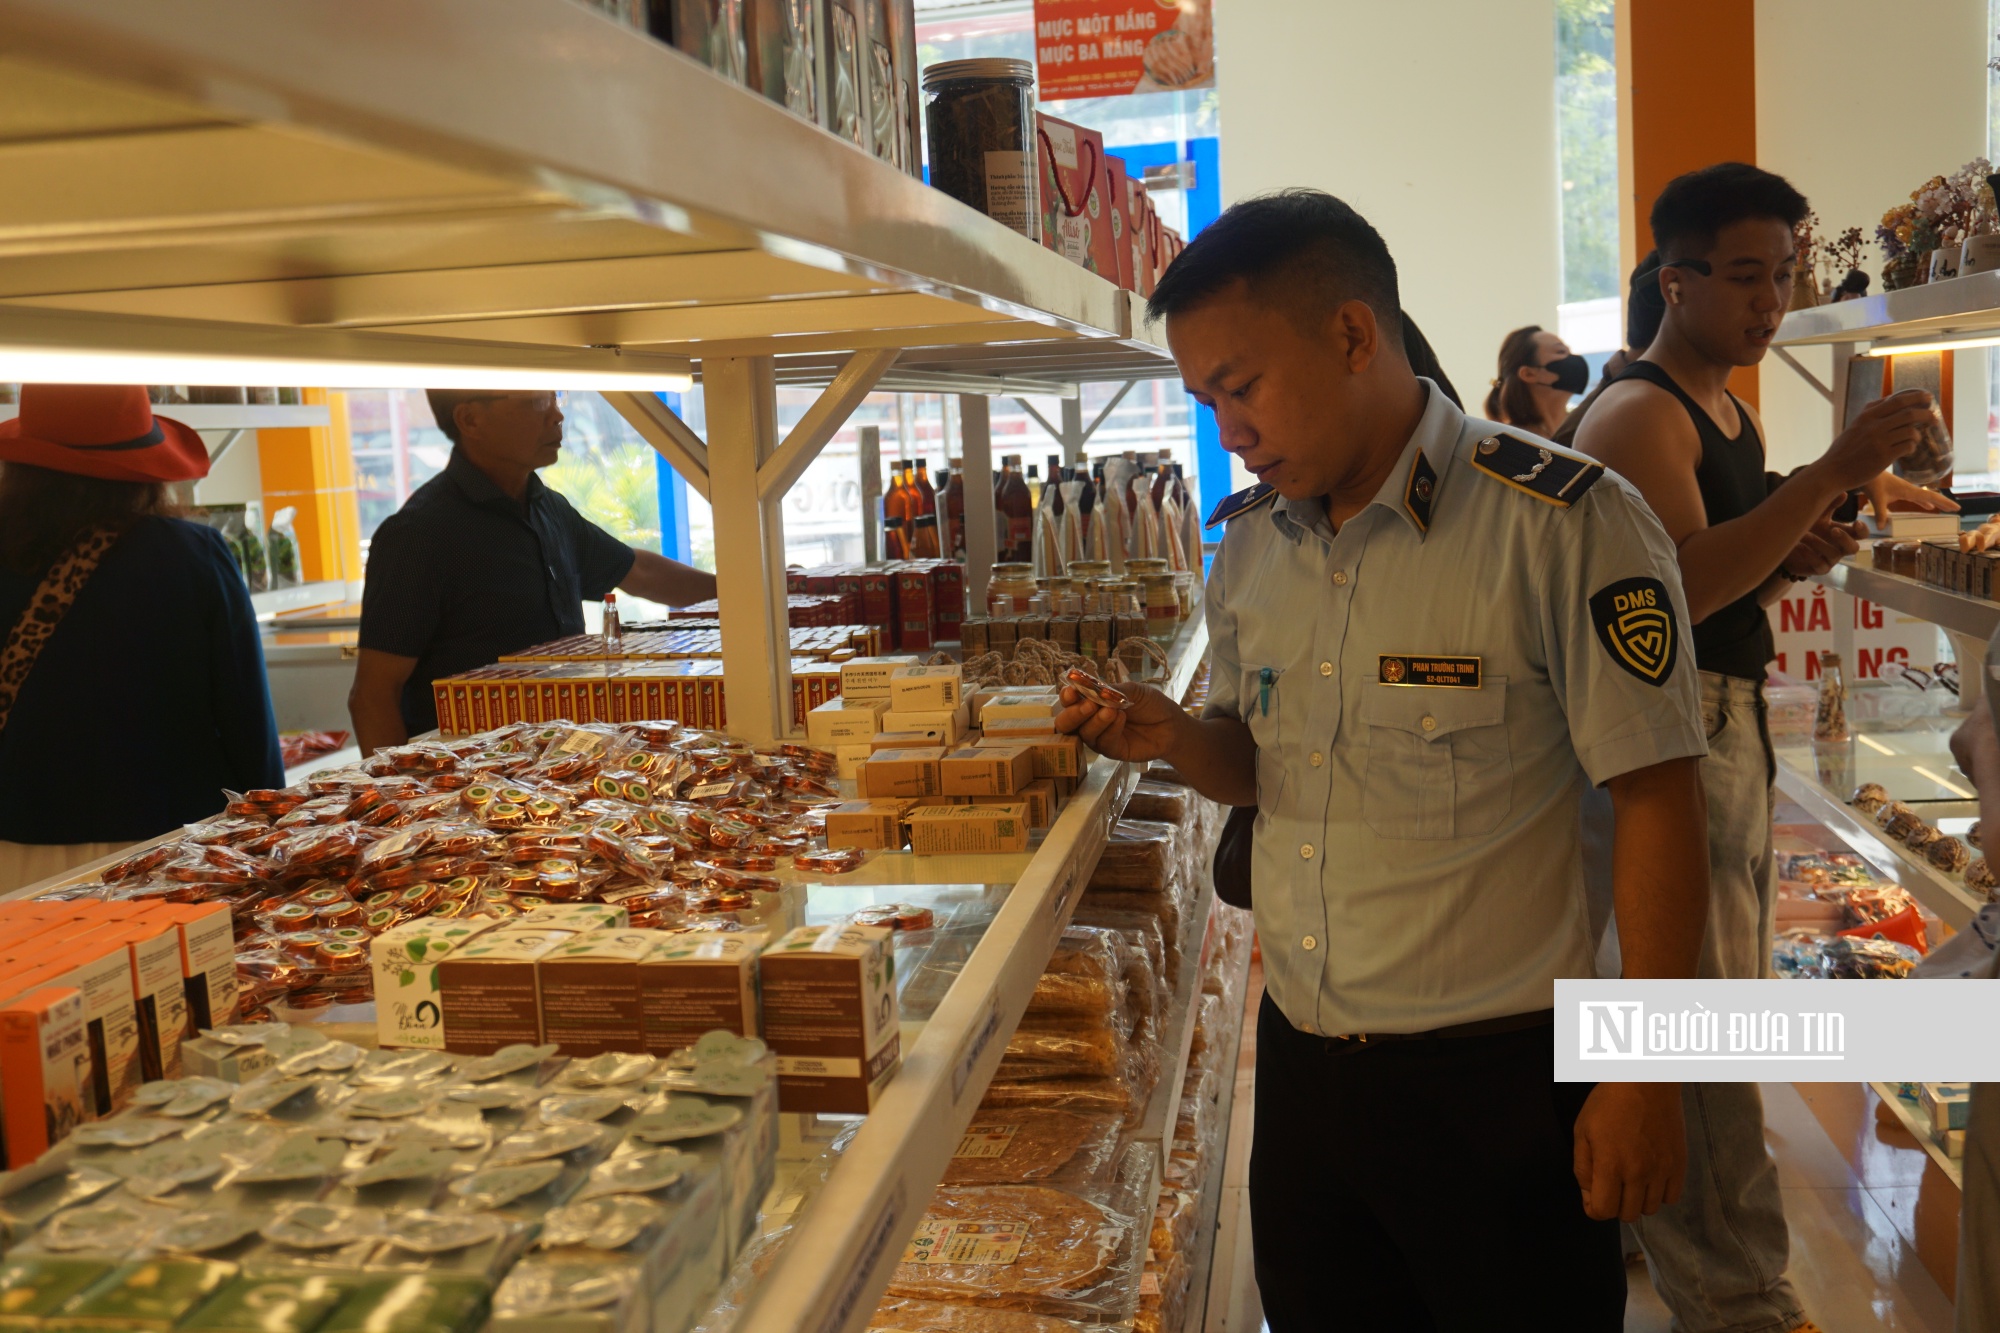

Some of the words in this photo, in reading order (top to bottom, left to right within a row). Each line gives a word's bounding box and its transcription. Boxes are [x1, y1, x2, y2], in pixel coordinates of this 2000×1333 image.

[1077, 13, 1111, 38] MỘT
[1114, 8, 1157, 32] NẮNG
[1078, 44, 1099, 61] BA
[1103, 35, 1144, 59] NẮNG
[1613, 588, 1657, 612] DMS
[1780, 584, 1884, 632] NẮG
[1412, 662, 1430, 672] PHAN
[1455, 663, 1475, 674] TRINH
[409, 1035, 430, 1045] CAO
